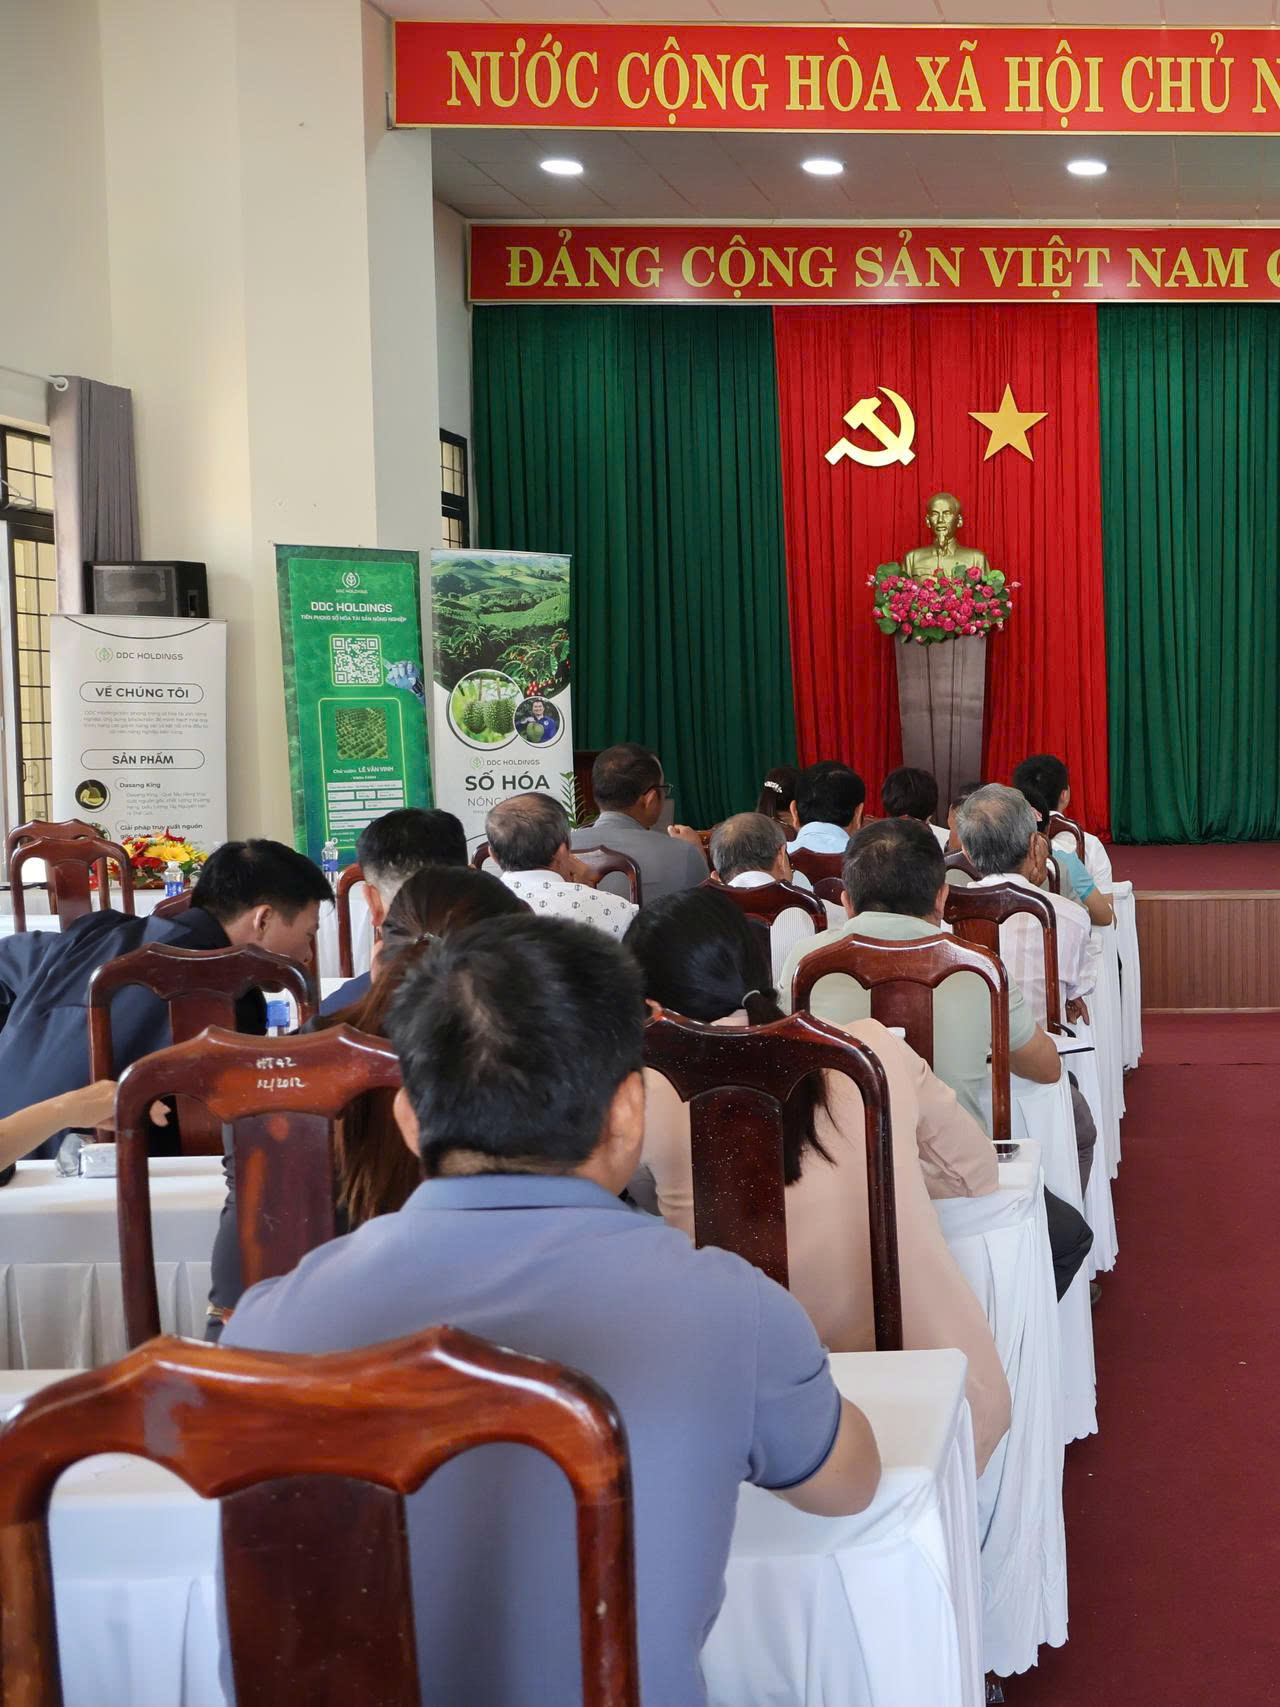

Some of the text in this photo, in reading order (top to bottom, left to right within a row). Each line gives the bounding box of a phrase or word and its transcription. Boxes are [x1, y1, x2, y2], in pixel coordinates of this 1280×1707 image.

[447, 36, 599, 108] NƯỚC
[616, 36, 769, 124] CỘNG
[786, 37, 901, 112] HÒA
[916, 40, 986, 112] XÃ
[1005, 39, 1104, 127] HỘI
[1121, 31, 1234, 114] CHỦ
[505, 229, 663, 288] ĐẢNG
[681, 235, 837, 299] CỘNG
[855, 229, 963, 288] SẢN
[980, 235, 1112, 299] VIỆT
[1127, 247, 1249, 289] NAM
[311, 602, 393, 613] DDC HOLDINGS
[116, 651, 184, 661] DDC HOLDINGS
[115, 686, 164, 699] CHÚNG
[166, 687, 189, 699] TÔI
[112, 751, 174, 765] SẢN PHẨM
[146, 781, 161, 789] King
[465, 769, 550, 791] SỐ HÓA
